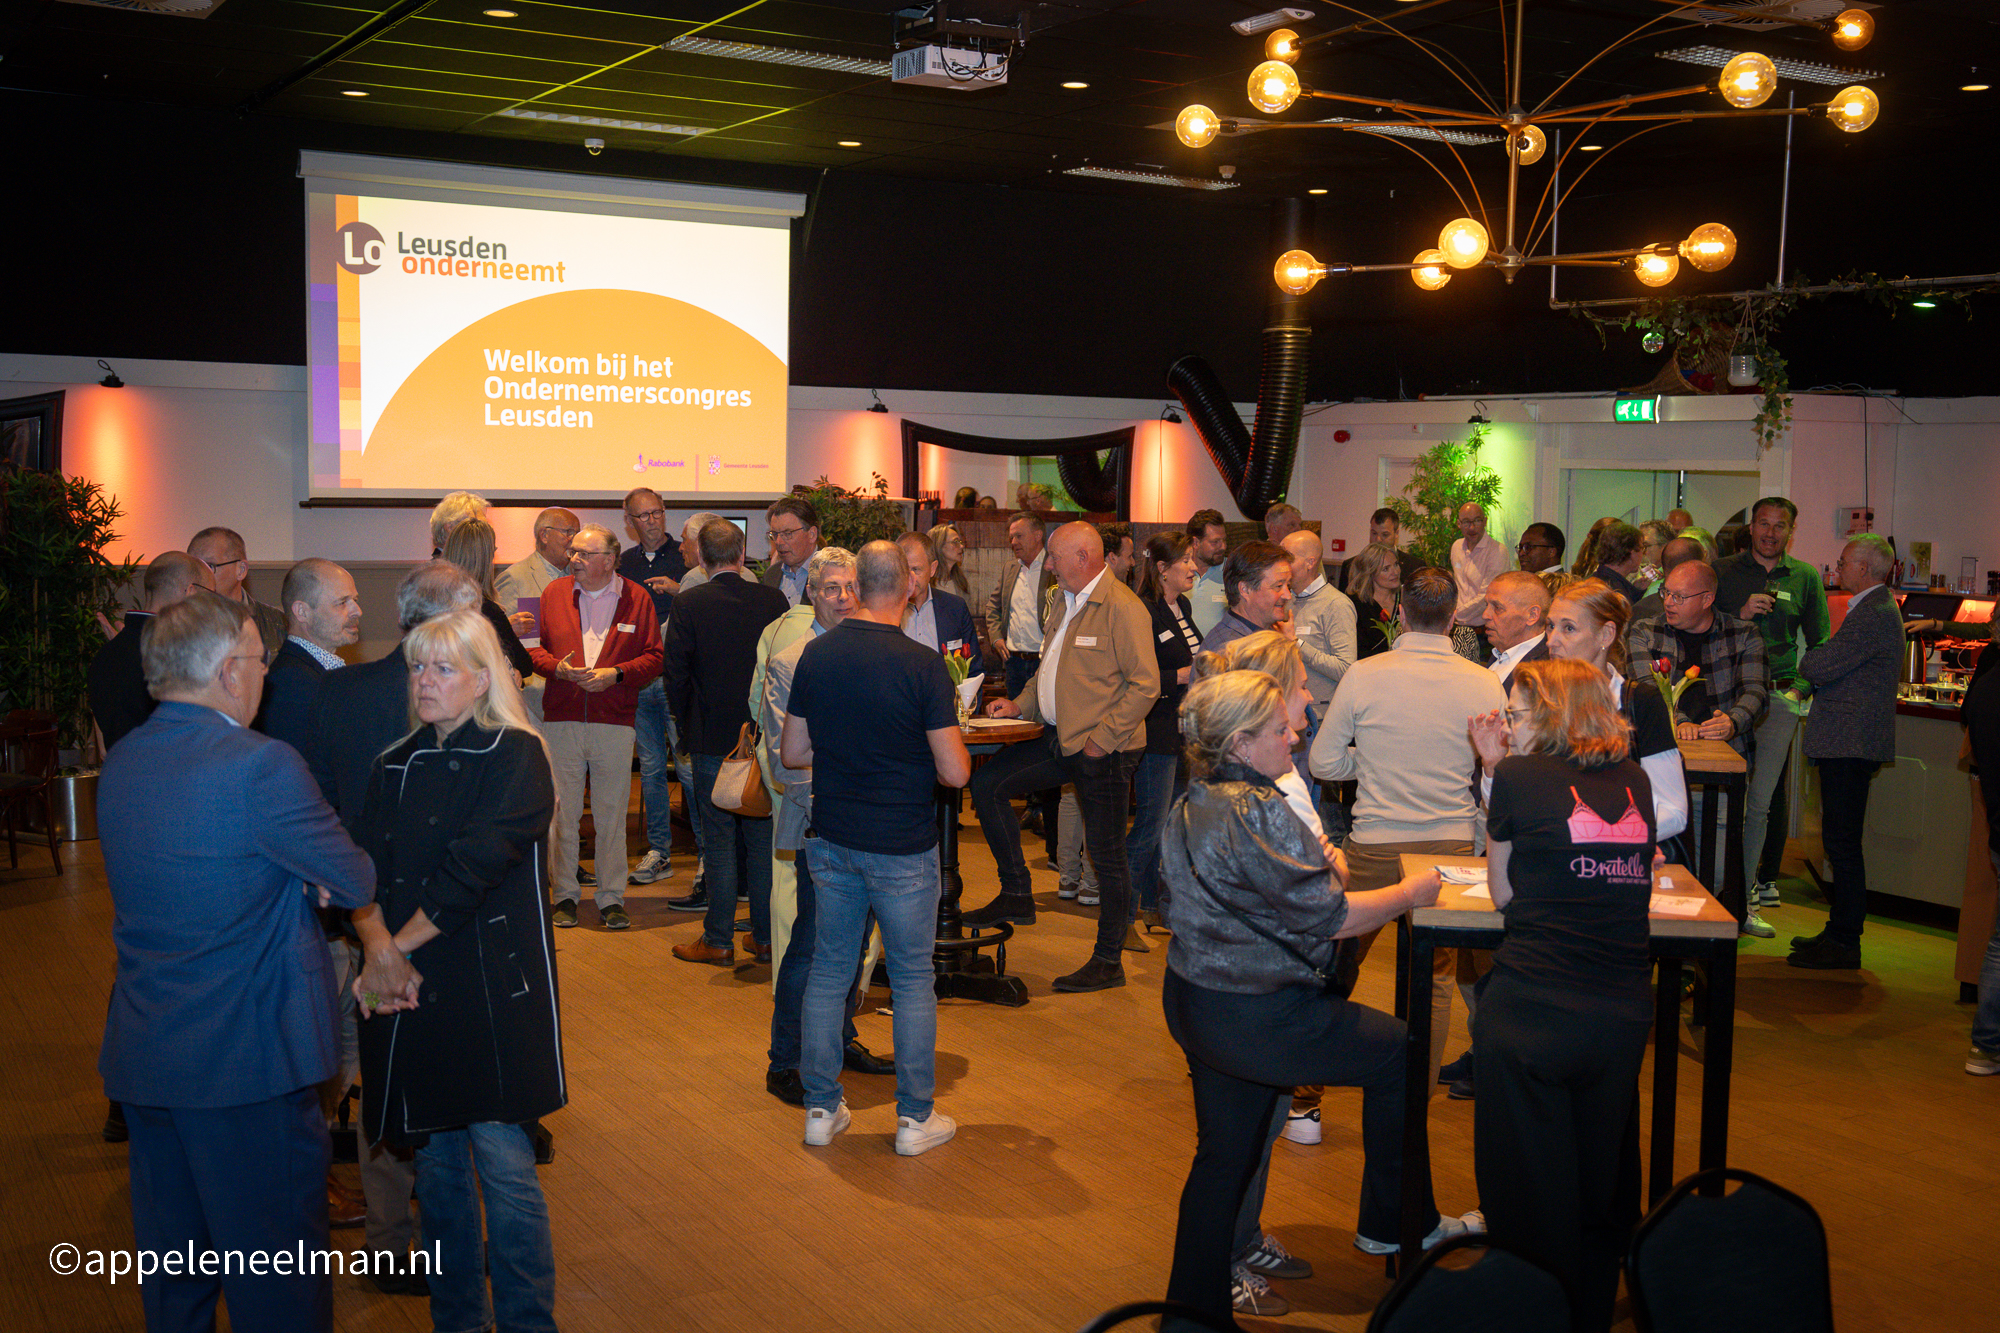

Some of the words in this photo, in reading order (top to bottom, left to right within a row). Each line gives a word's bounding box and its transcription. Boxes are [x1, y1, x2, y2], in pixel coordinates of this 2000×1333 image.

[344, 231, 384, 266] Lo
[397, 231, 507, 260] Leusden
[402, 256, 566, 283] onderneemt
[483, 348, 589, 375] Welkom
[596, 353, 627, 381] bij
[633, 355, 673, 378] het
[484, 376, 752, 410] Ondernemerscongres
[484, 404, 594, 429] Leusden
[648, 459, 685, 468] Rabobank
[1570, 852, 1645, 878] Bratelle
